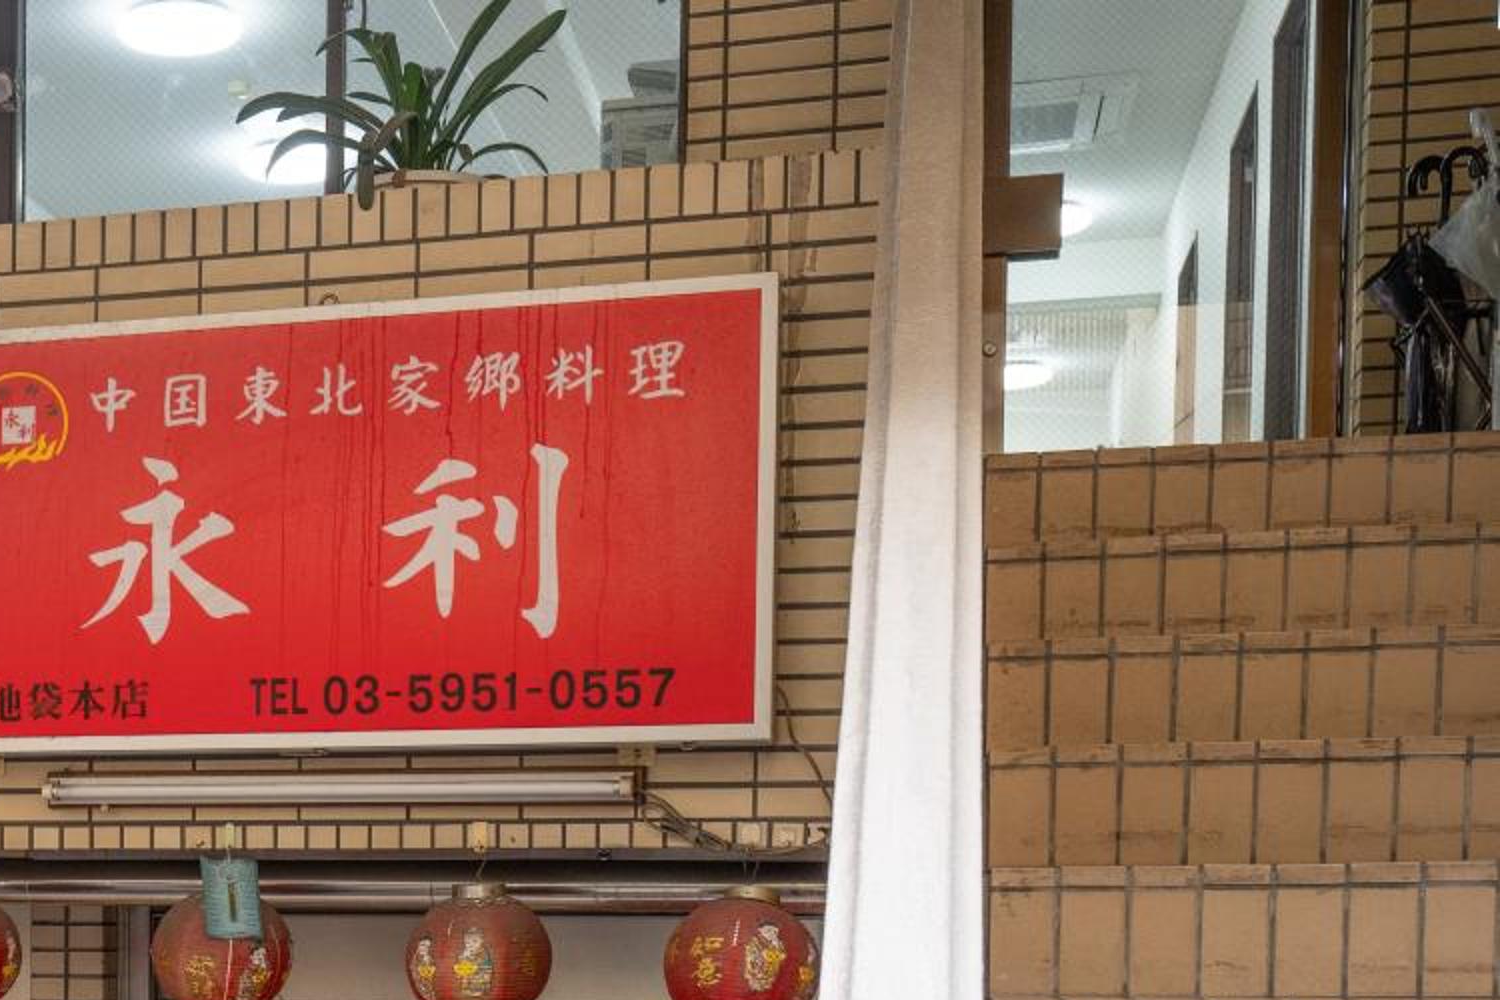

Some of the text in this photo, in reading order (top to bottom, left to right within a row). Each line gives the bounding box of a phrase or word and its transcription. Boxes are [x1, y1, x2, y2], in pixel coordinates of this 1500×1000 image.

[89, 340, 689, 433] 中国東北家郷料理
[79, 443, 569, 646] 永利
[250, 667, 675, 716] TEL 03-5951-0557
